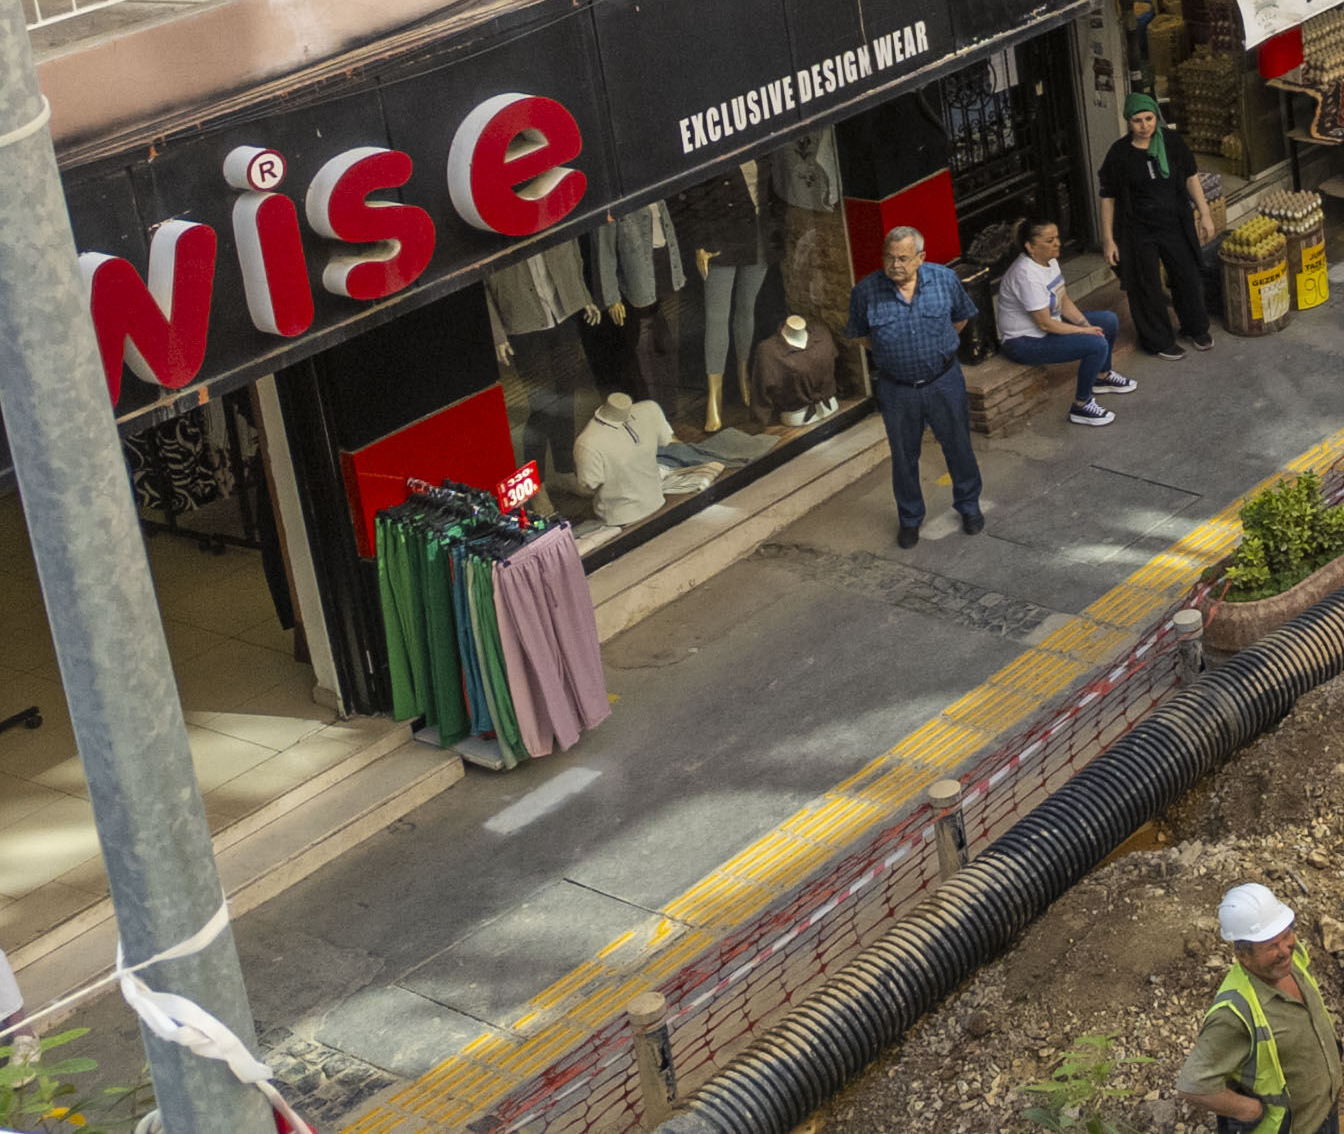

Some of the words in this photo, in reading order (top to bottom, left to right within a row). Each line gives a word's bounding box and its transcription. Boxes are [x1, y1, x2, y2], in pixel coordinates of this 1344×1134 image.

[679, 75, 796, 155] EXCLUSIVE
[797, 44, 873, 105] DESIGN
[872, 20, 930, 71] WEAR
